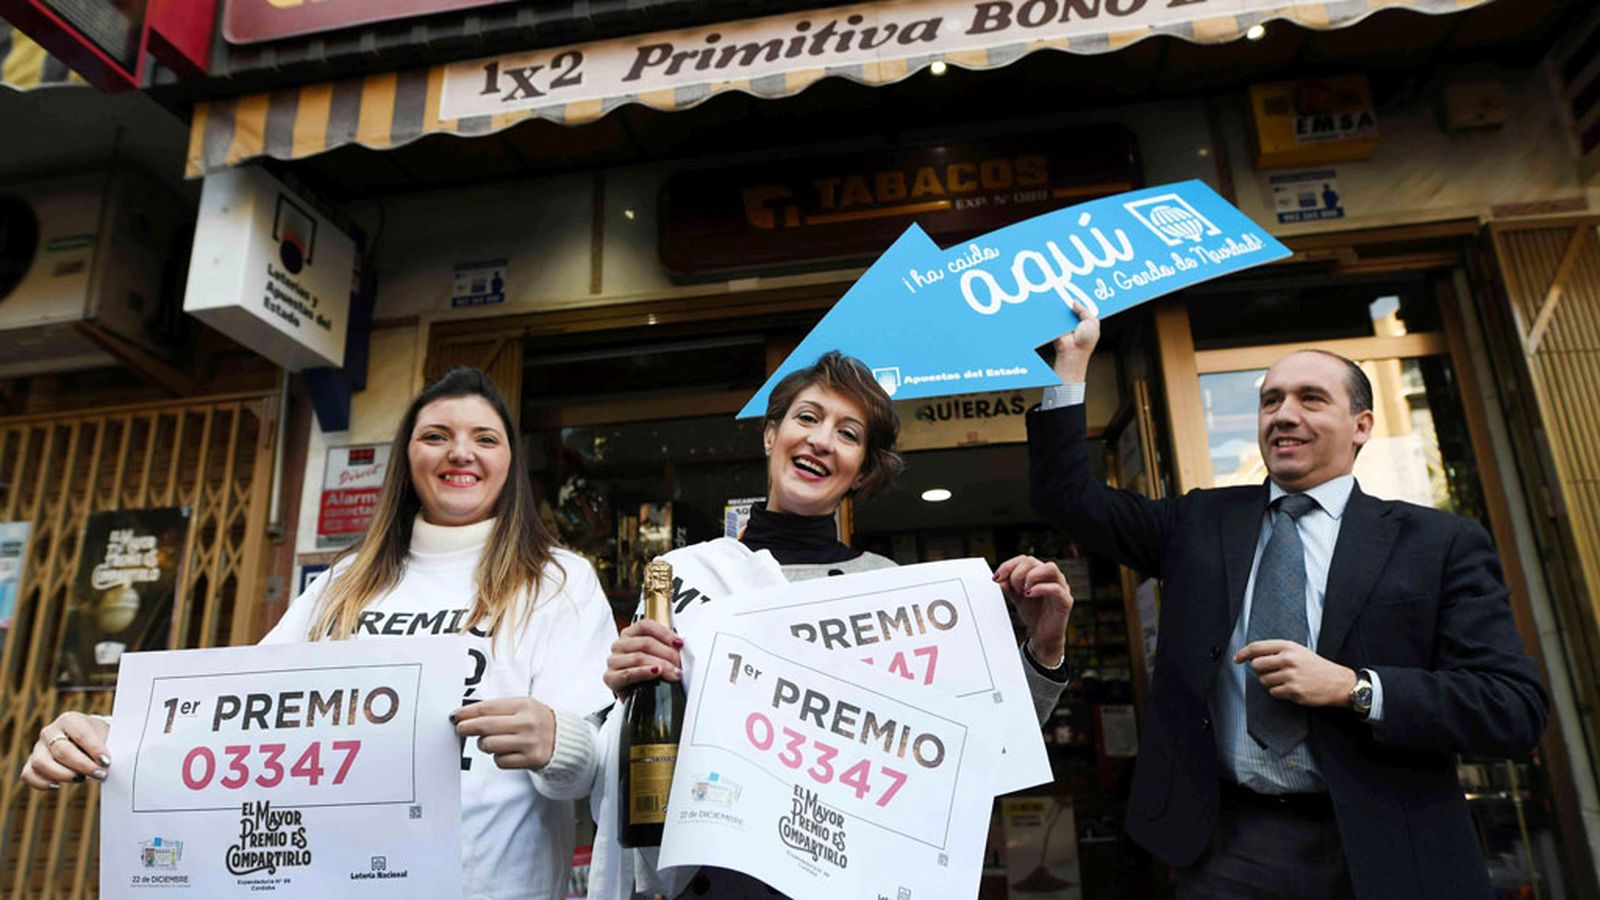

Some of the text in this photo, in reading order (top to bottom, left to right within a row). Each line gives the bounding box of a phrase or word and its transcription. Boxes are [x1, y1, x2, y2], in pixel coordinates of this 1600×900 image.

[622, 15, 943, 82] Primitiva
[966, 0, 1147, 34] BONO
[1297, 111, 1374, 135] EMSA
[814, 153, 1048, 209] TABACOS
[960, 212, 1135, 319] aquí
[1094, 278, 1116, 300] el
[1170, 252, 1199, 272] de
[263, 296, 300, 328] Estado
[266, 281, 332, 331] Apuestas del
[904, 367, 1029, 385] Apuestas del Estado
[916, 397, 1026, 422] QUIERAS
[327, 492, 377, 506] Alarm
[789, 599, 959, 650] PREMIO
[163, 686, 400, 734] 1er PREMIO
[728, 653, 946, 769] 1er PREMIO
[181, 740, 362, 790] 03347
[745, 712, 908, 807] 03347
[242, 800, 302, 832] EL MAYOR
[791, 798, 846, 851] PREMIO ES
[793, 784, 845, 829] EL MAYOR
[239, 818, 307, 851] PREMIO ES
[778, 816, 848, 869] COMPARTIRLO
[132, 875, 189, 883] 22 de DICIEMBRE
[226, 844, 312, 875] COMPARTIRLO
[377, 870, 408, 879] Nacional
